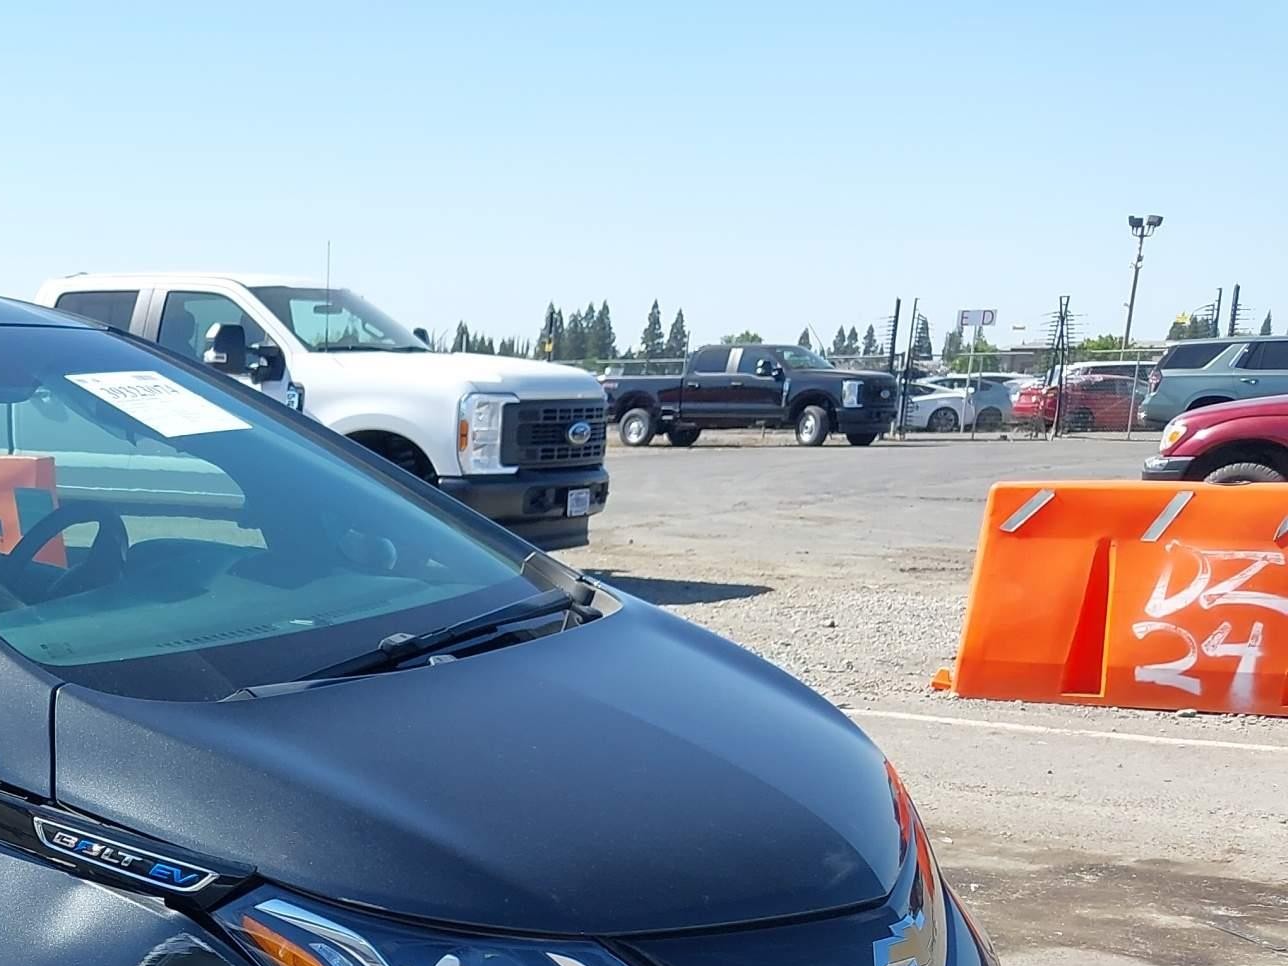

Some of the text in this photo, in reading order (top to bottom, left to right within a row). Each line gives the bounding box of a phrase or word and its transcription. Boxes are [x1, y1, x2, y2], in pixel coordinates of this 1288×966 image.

[960, 310, 995, 326] E D
[1132, 621, 1264, 711] 24
[52, 831, 200, 884] BOLT EV
